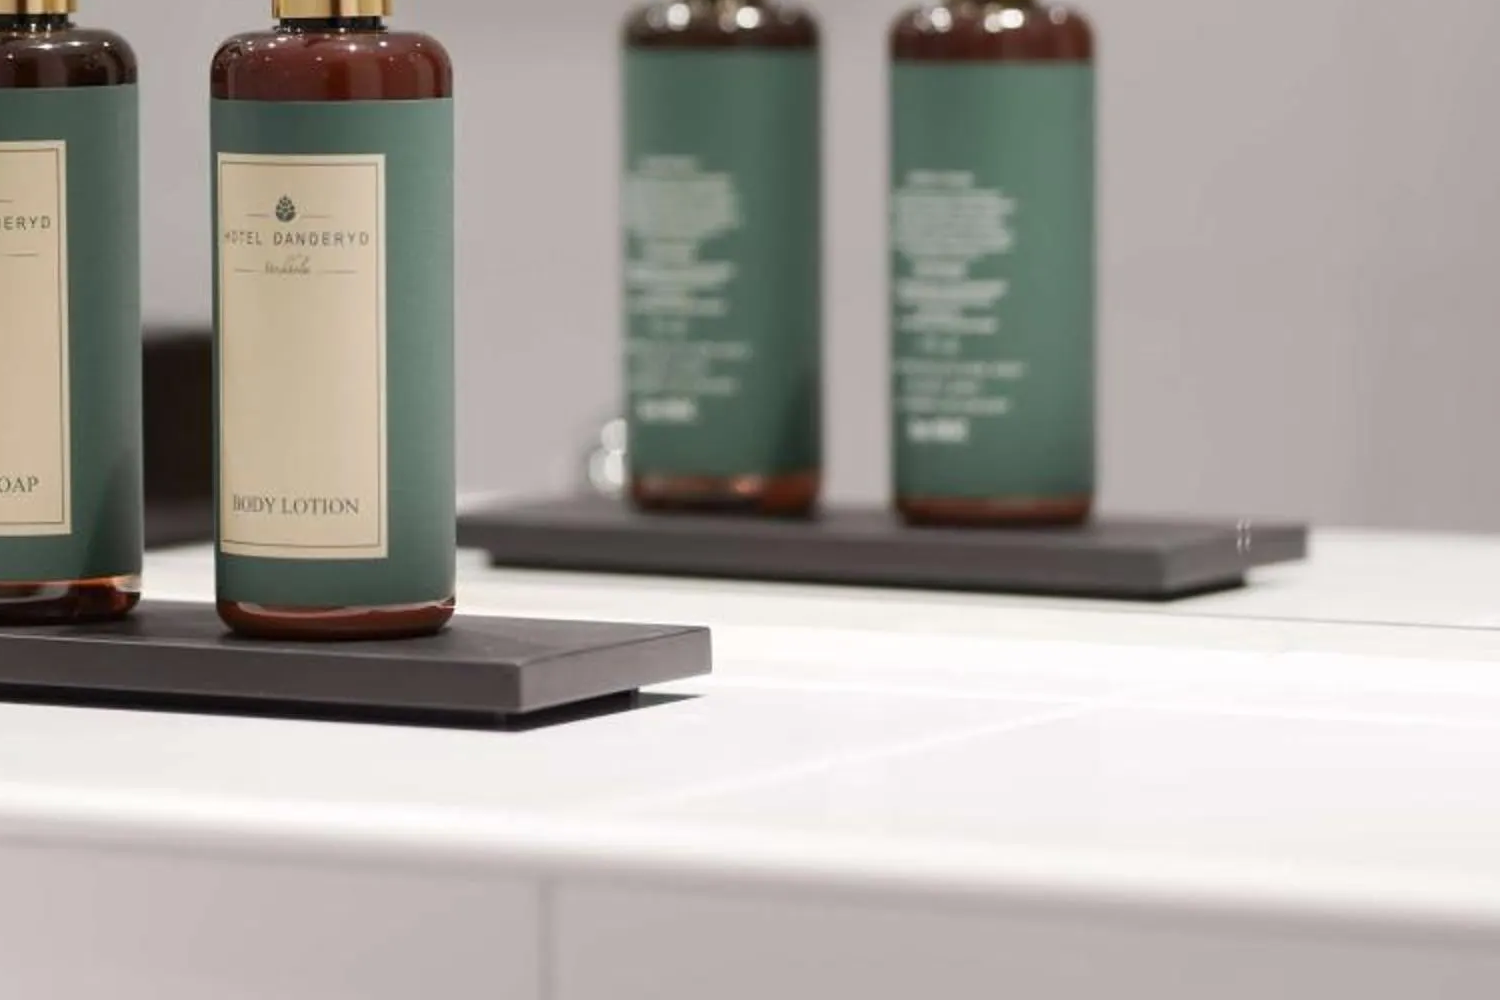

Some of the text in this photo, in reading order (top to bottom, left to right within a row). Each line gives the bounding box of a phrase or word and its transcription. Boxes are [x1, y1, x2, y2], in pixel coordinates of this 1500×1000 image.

[273, 231, 369, 247] DANDERYD
[233, 494, 360, 515] BODY LOTION
